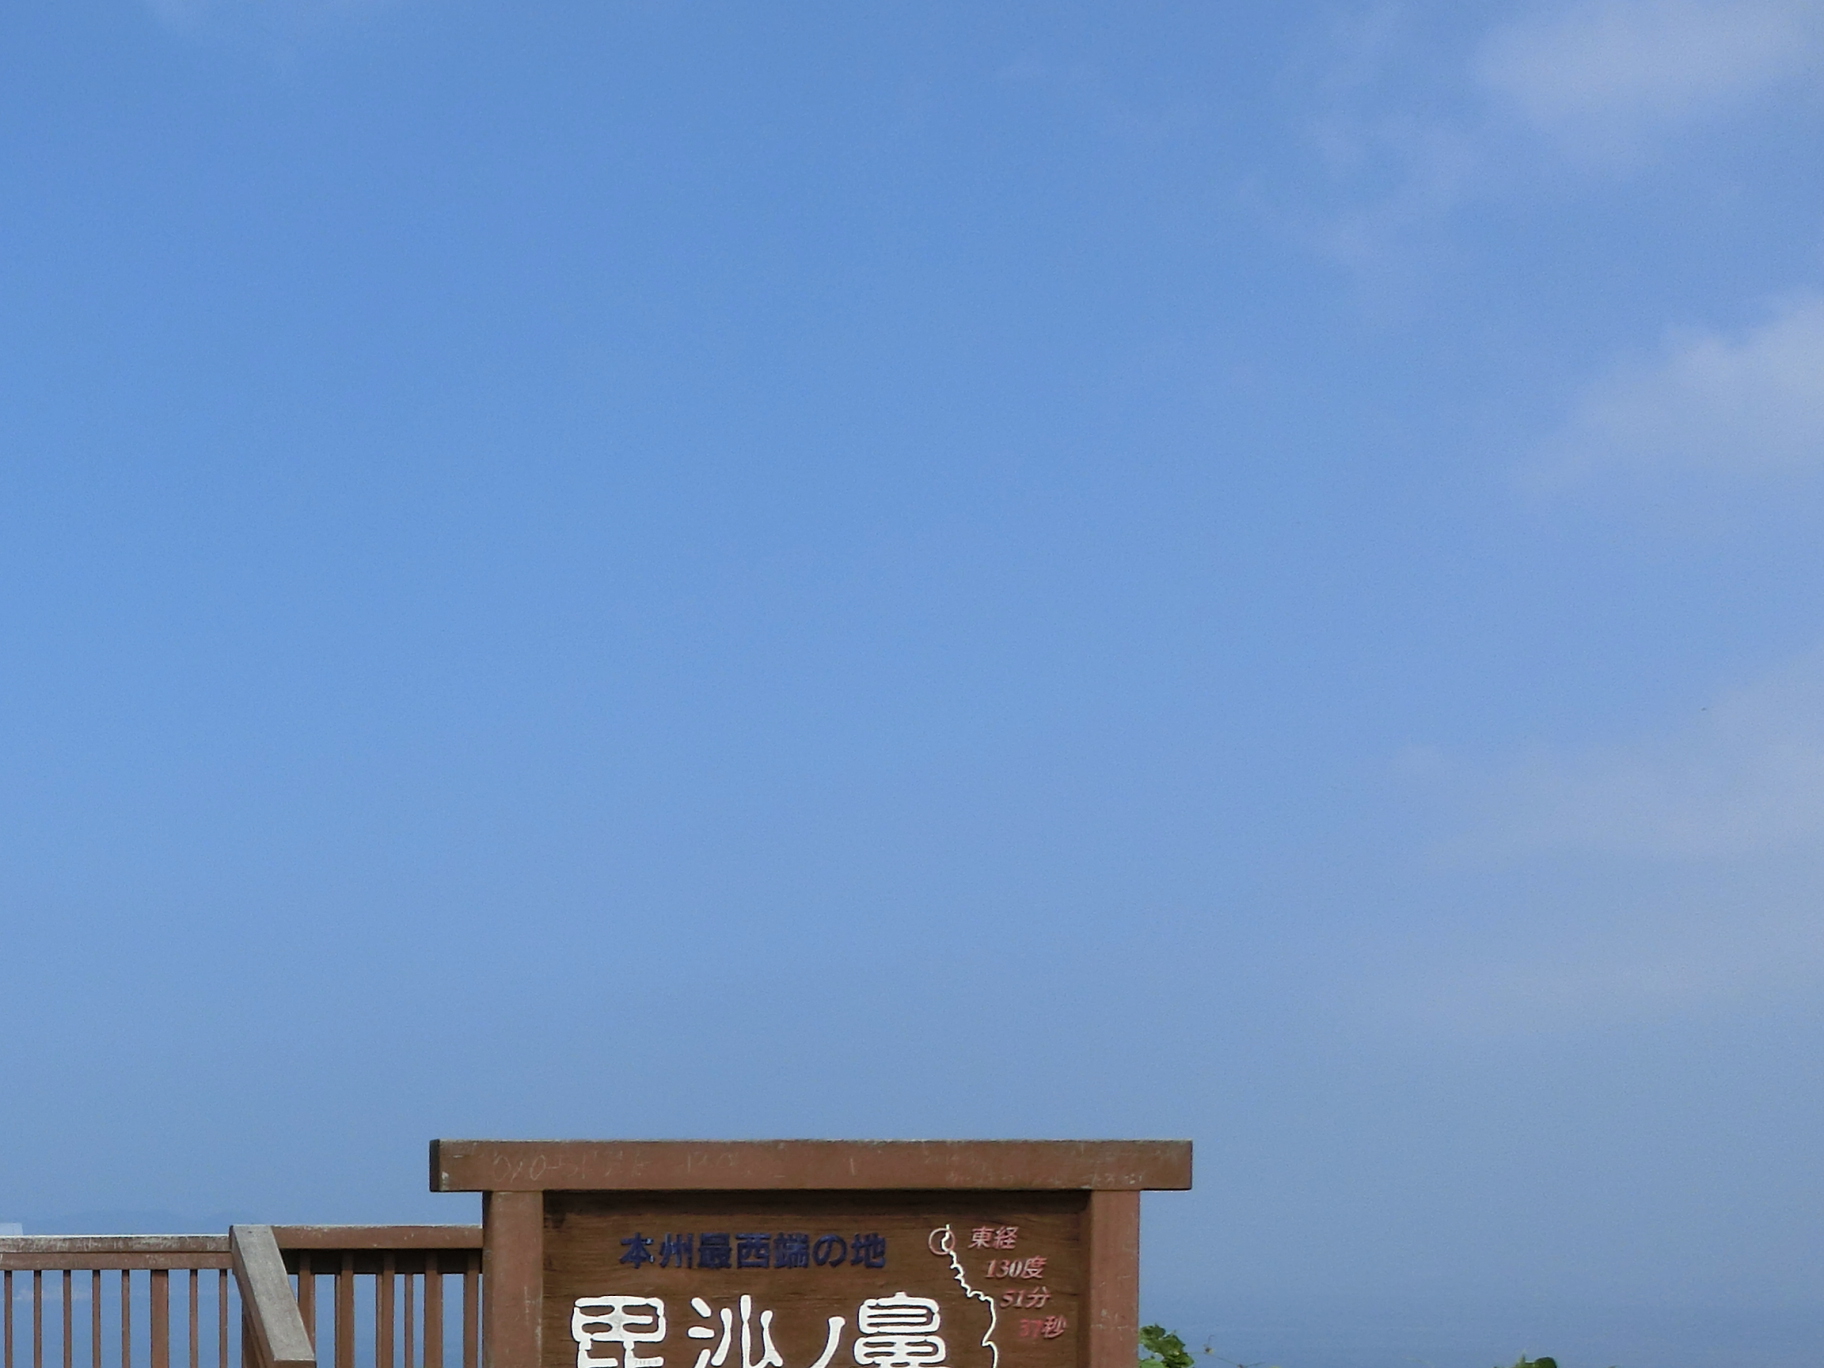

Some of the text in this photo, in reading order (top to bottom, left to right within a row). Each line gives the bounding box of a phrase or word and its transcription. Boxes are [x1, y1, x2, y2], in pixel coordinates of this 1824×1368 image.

[968, 1226, 1019, 1249] 東経
[619, 1232, 886, 1269] 本州最西端の地
[985, 1255, 1048, 1279] 130度
[1000, 1286, 1052, 1308] 51分
